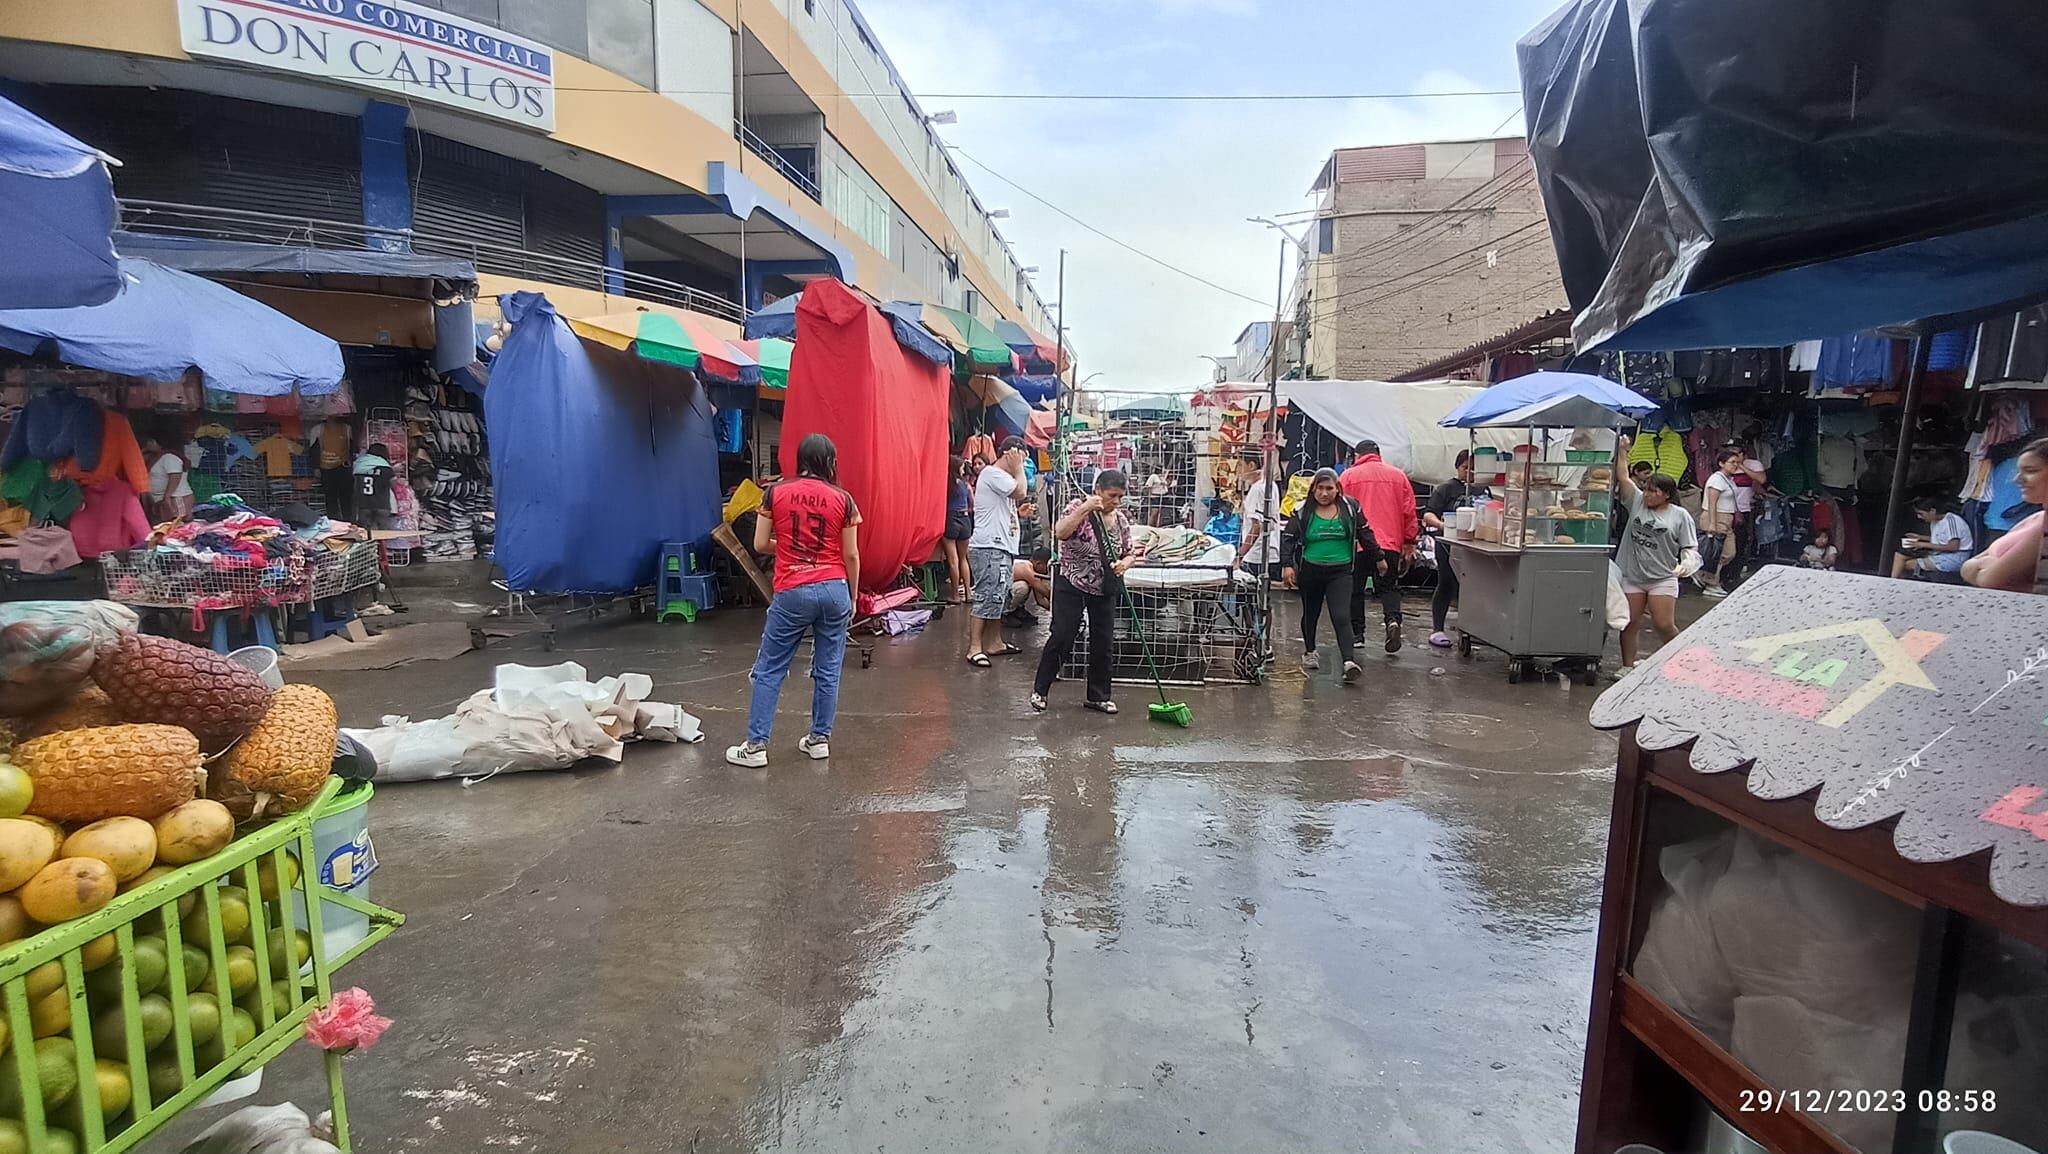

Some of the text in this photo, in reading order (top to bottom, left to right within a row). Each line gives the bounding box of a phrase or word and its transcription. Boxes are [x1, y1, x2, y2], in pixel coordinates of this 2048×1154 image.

[202, 5, 544, 118] DON CARLOS
[355, 3, 541, 70] COMERCIAL
[789, 510, 826, 553] 13
[1770, 651, 1849, 688] LA
